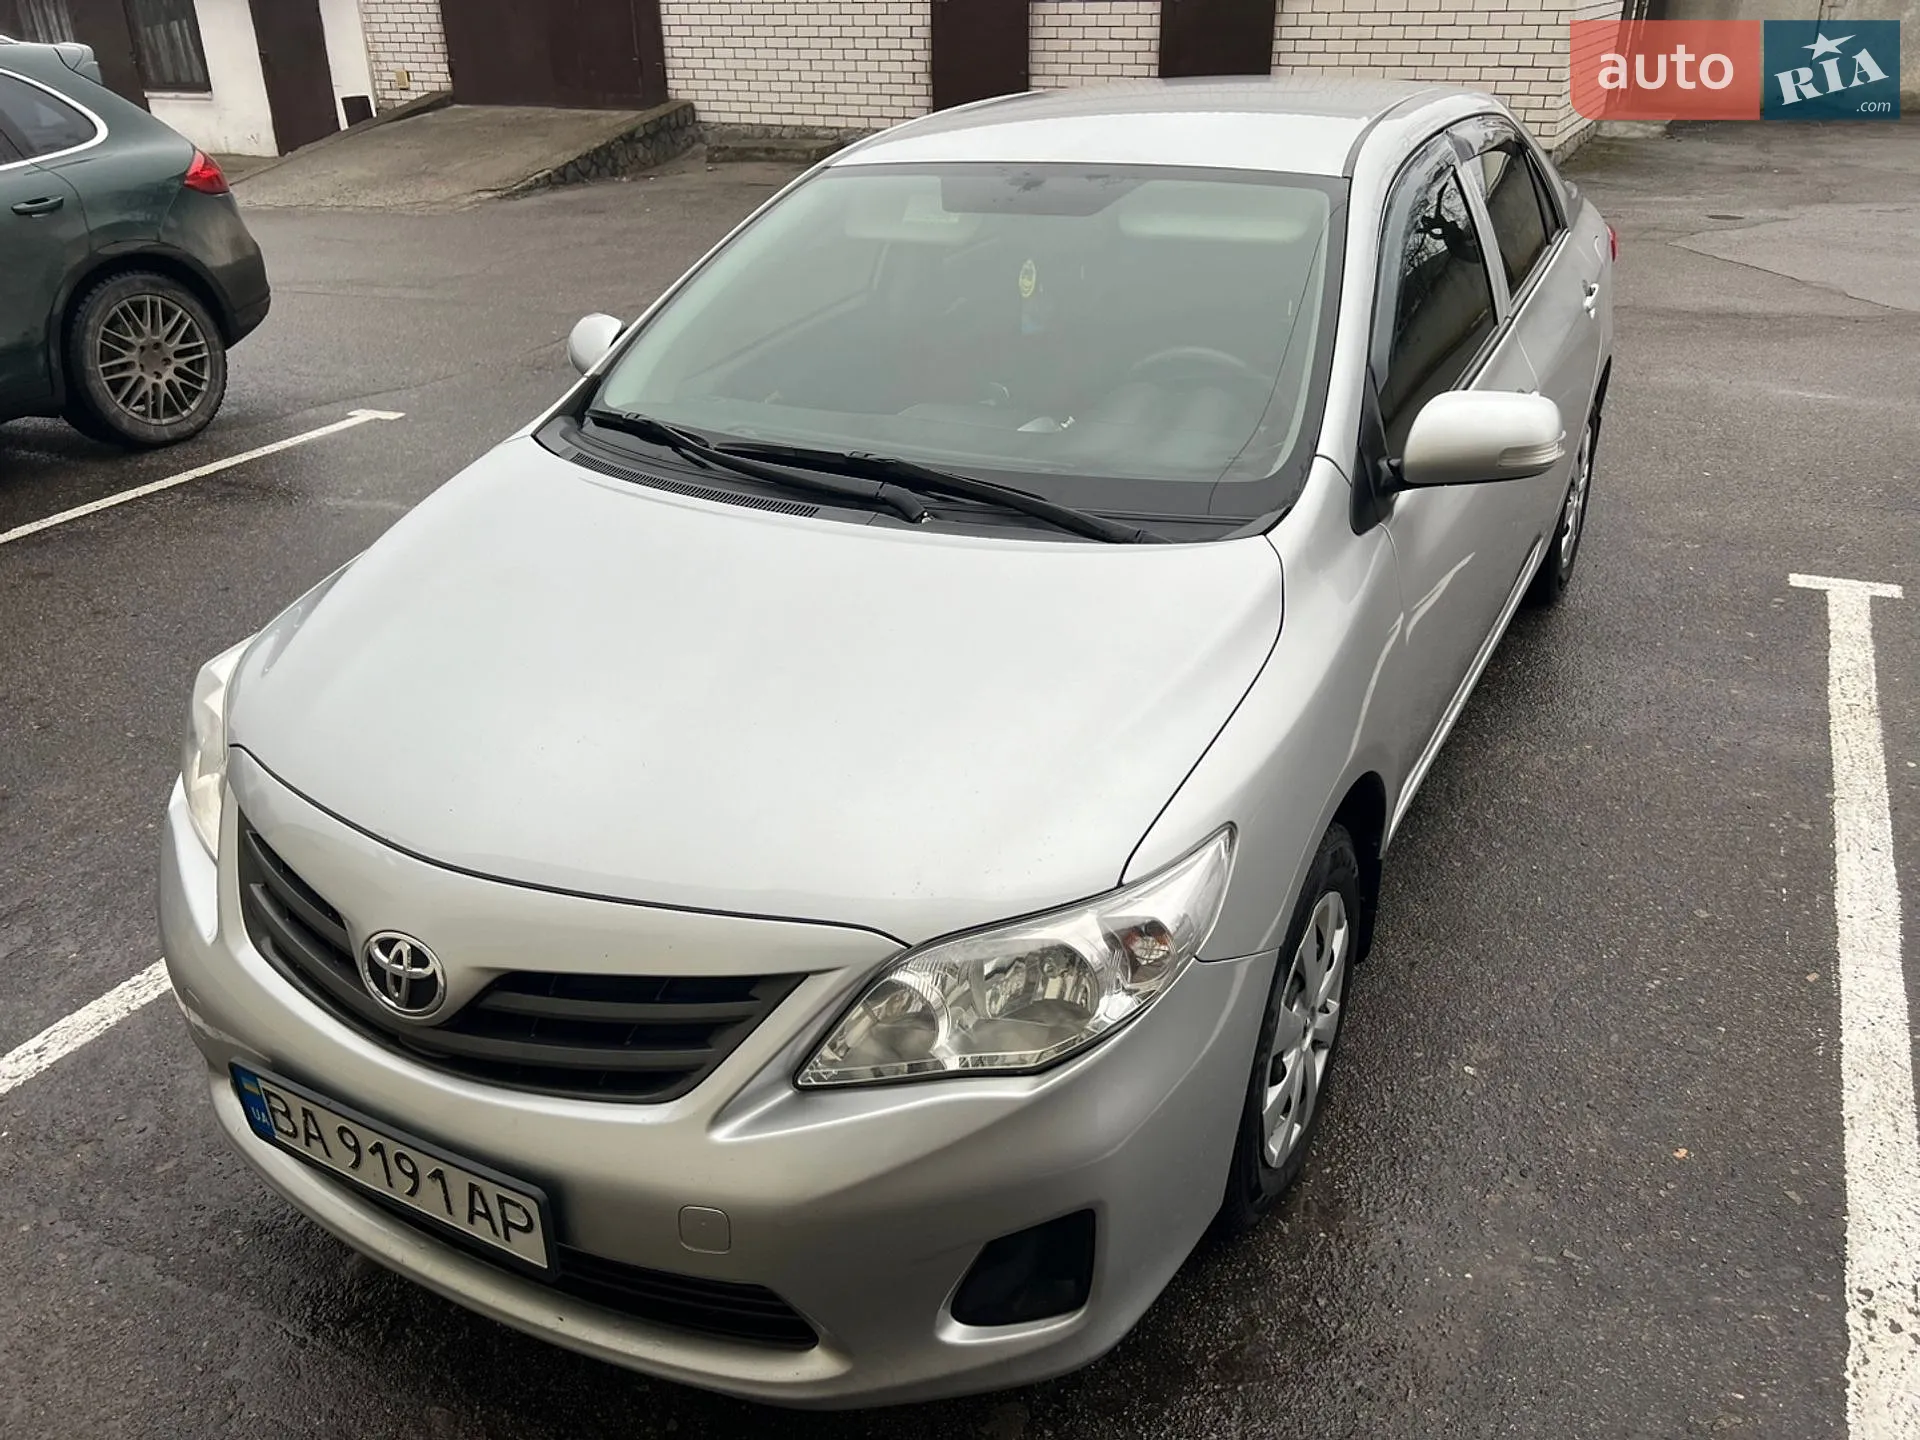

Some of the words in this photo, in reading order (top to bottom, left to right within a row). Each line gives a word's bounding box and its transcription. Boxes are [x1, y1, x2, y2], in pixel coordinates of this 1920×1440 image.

[250, 1105, 270, 1128] UA
[263, 1090, 333, 1160] BA
[336, 1124, 455, 1217] 9191
[467, 1181, 535, 1243] AP
